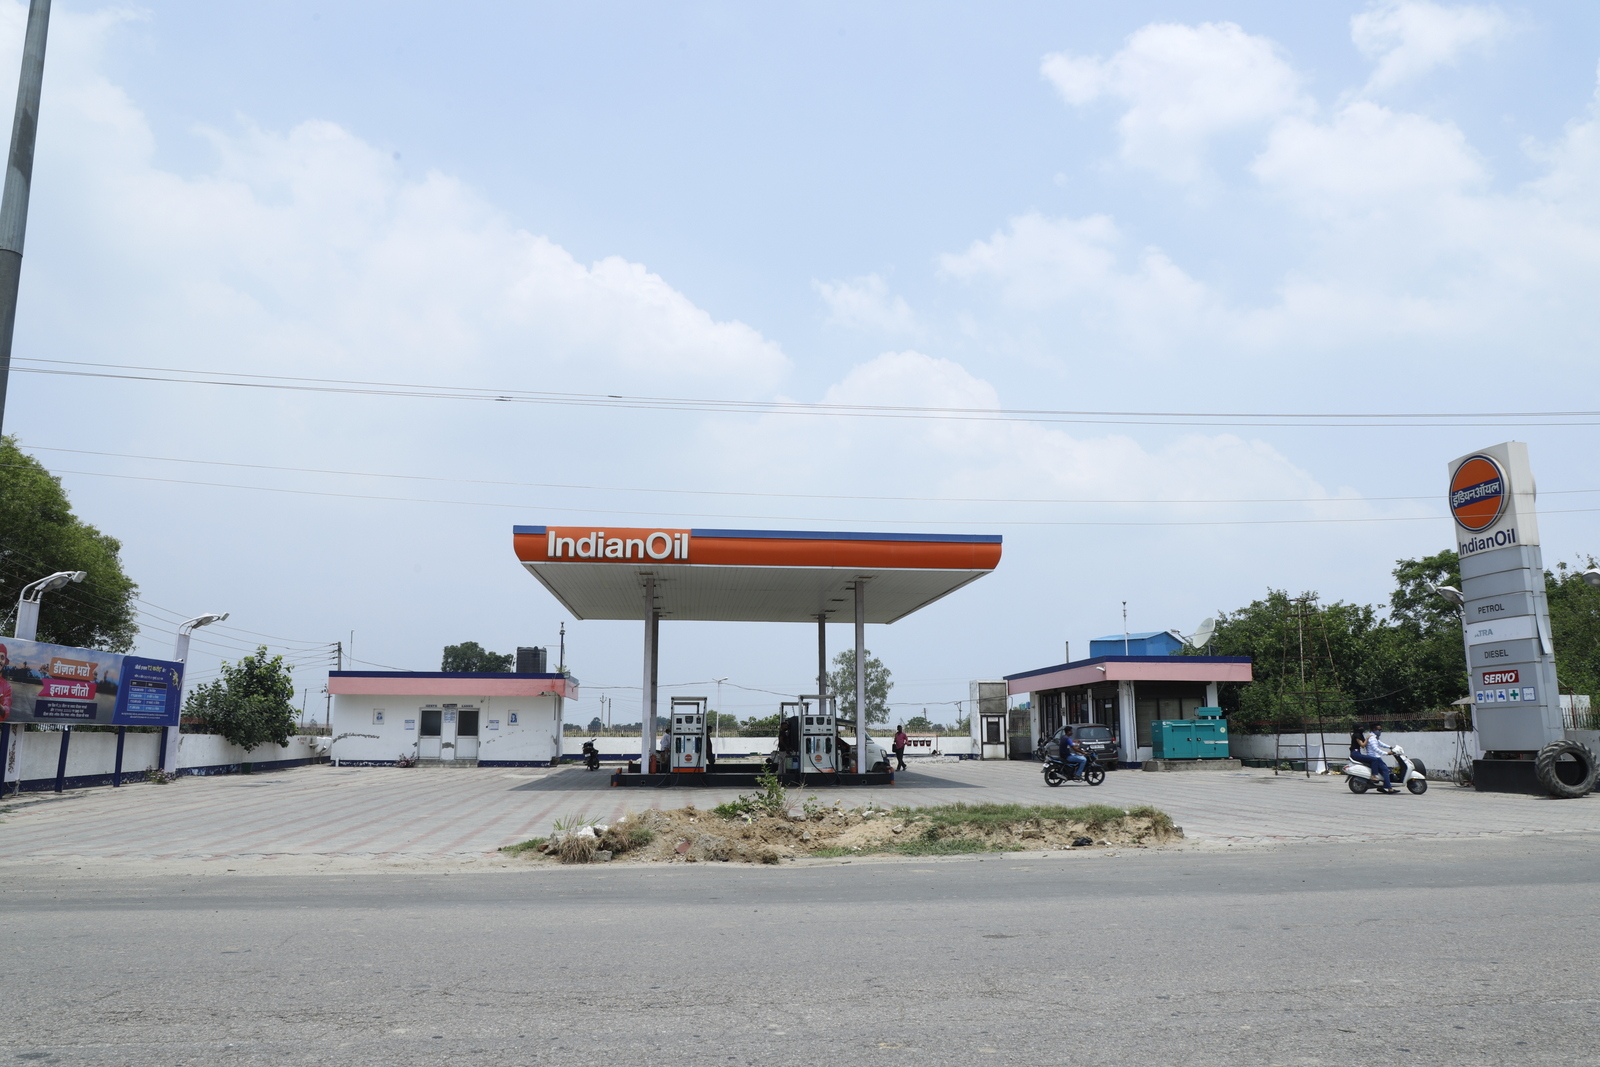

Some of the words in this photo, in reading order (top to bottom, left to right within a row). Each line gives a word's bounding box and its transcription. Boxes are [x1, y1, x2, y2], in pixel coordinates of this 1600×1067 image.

[1452, 481, 1500, 507] इंडियनऑयल
[547, 531, 689, 560] IndianOil
[1459, 528, 1516, 555] IndianOil
[1477, 603, 1505, 615] PETROL
[1484, 649, 1509, 659] DIESEL
[53, 661, 75, 675] डीज़ल
[77, 663, 90, 676] भरो
[1484, 672, 1516, 685] SERVO
[49, 683, 70, 697] इनाम
[71, 683, 89, 697] जीतो
